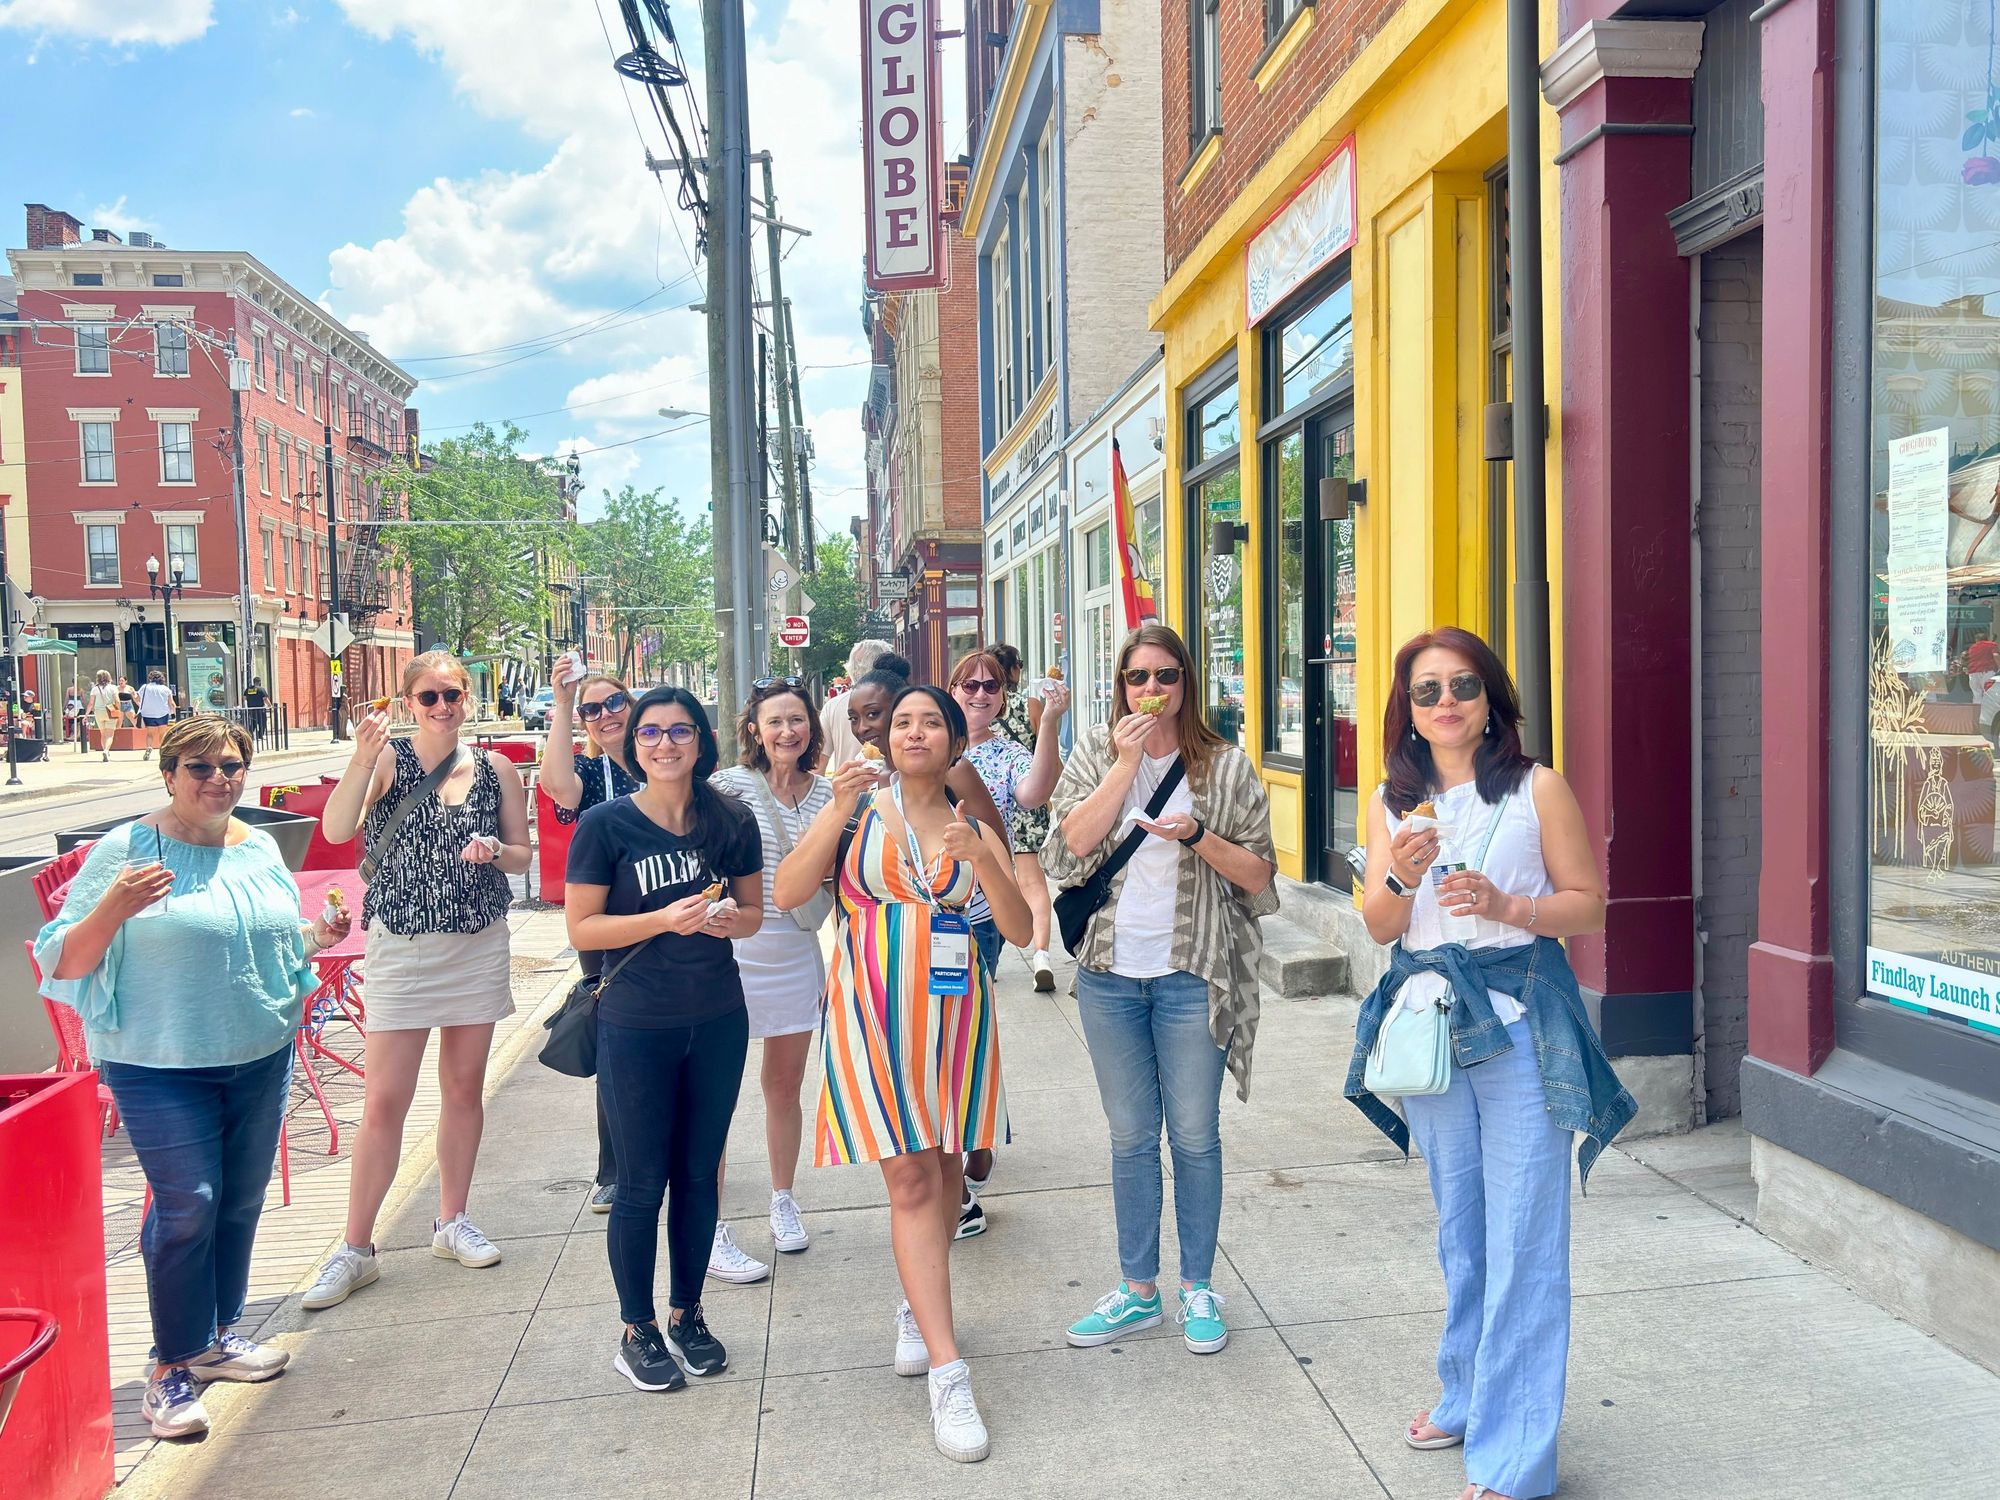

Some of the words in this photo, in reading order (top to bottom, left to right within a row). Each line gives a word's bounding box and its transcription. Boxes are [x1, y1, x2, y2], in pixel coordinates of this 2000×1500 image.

[877, 3, 919, 249] GLOBE
[1871, 960, 1926, 998] Findlay
[1930, 974, 1991, 1012] Launch
